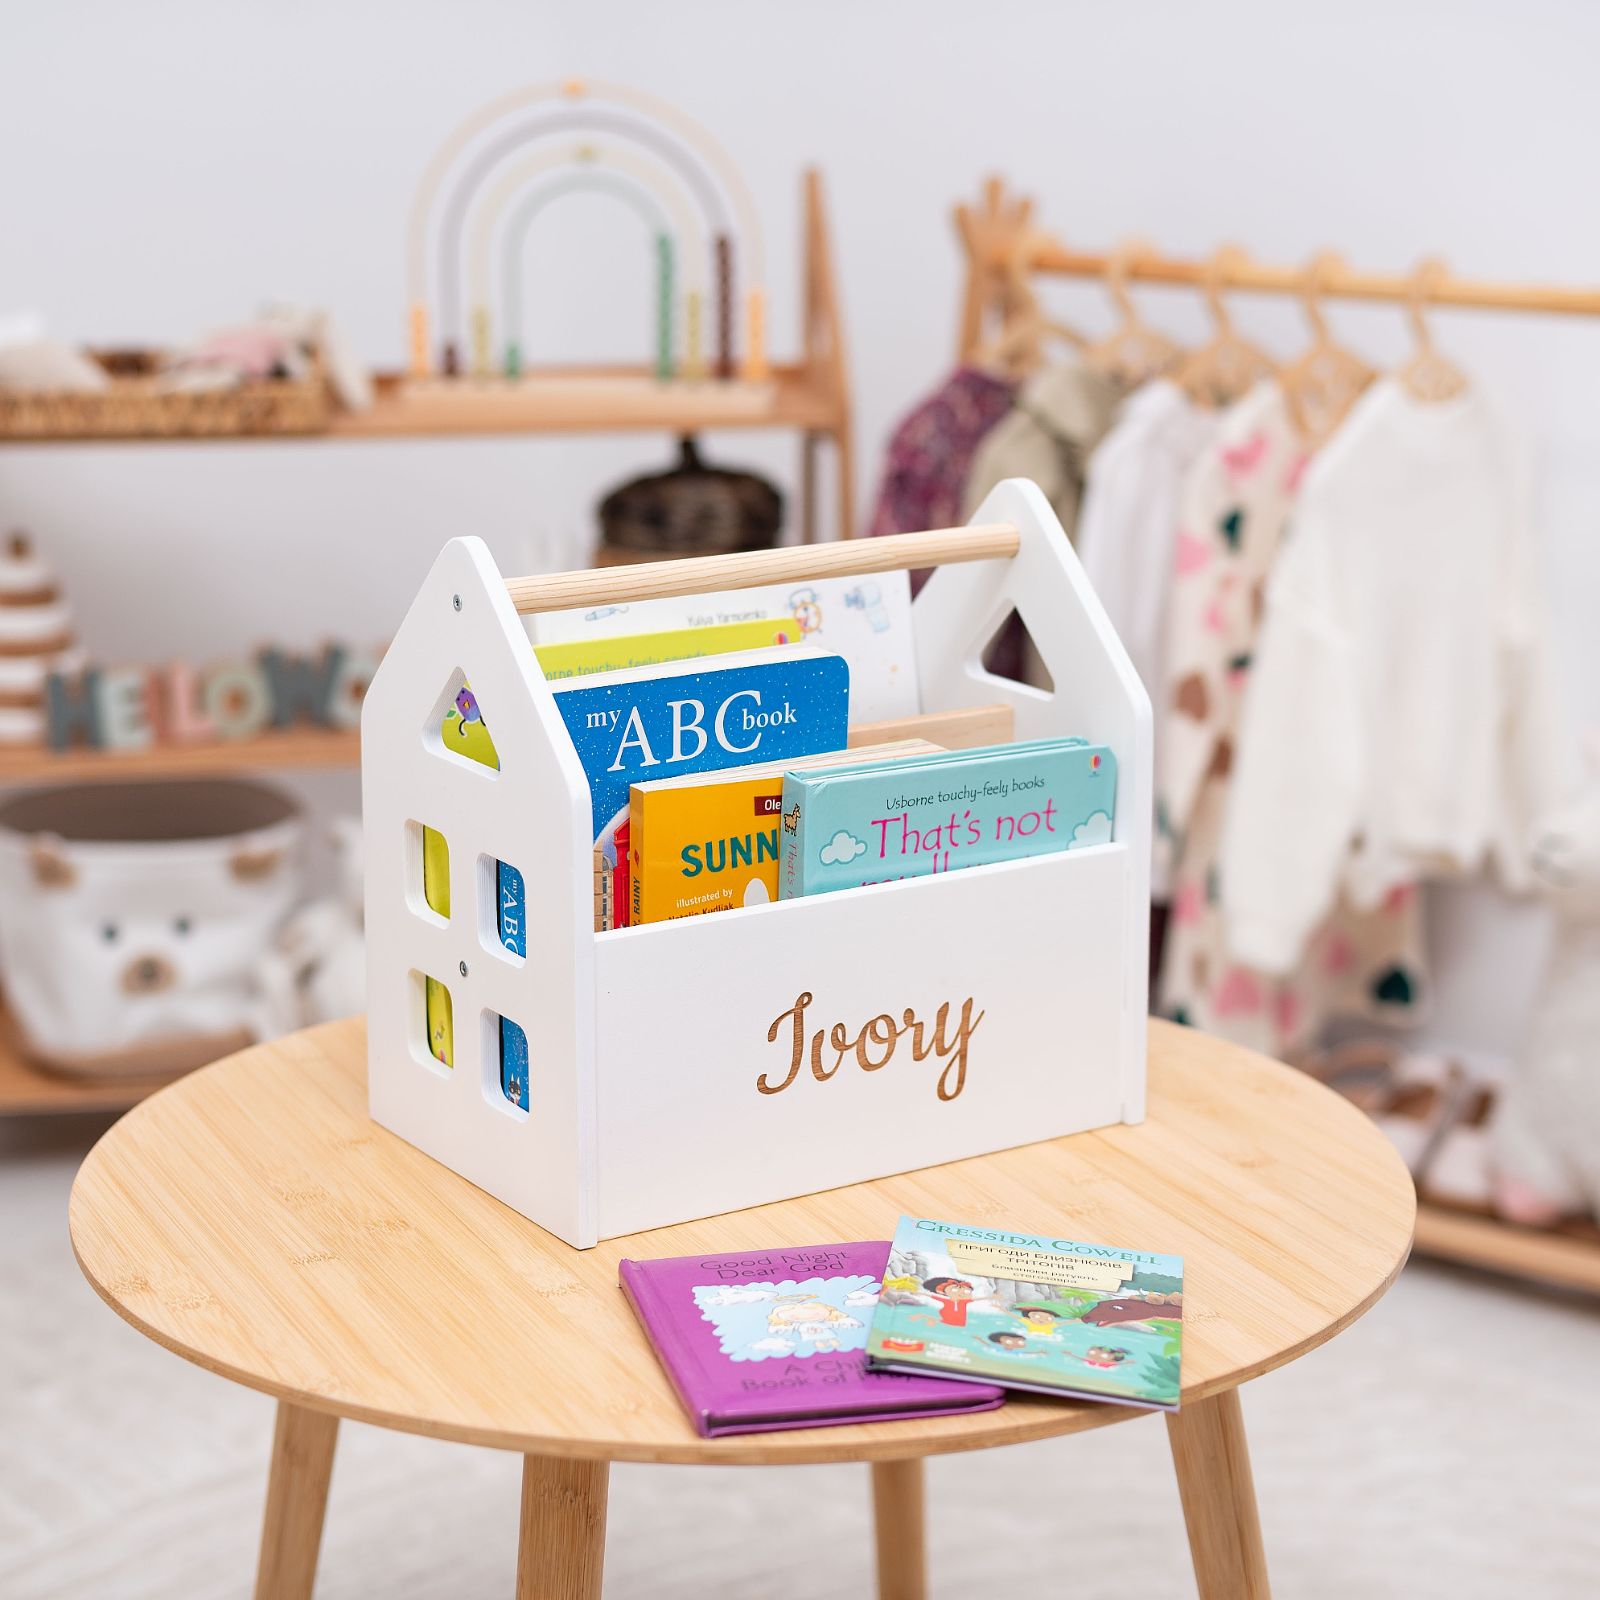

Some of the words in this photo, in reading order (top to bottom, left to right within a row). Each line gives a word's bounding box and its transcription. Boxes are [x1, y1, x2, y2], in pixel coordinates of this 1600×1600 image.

[586, 709, 621, 733] my
[607, 690, 762, 772] ABC
[743, 702, 797, 730] book
[764, 798, 781, 811] Ole
[886, 793, 934, 811] Usborne
[938, 780, 1009, 803] touchy-feely
[1012, 776, 1045, 792] books
[871, 809, 981, 859] That's
[995, 798, 1058, 841] not
[680, 829, 779, 878] SUNN
[633, 877, 641, 915] RAINY
[676, 891, 720, 909] illustrated
[722, 888, 734, 899] by
[756, 991, 985, 1101] Ivory
[700, 1256, 773, 1270] Good
[781, 1250, 850, 1264] Night
[717, 1267, 780, 1280] Dear
[790, 1260, 845, 1273] God
[814, 1359, 866, 1374] Chil
